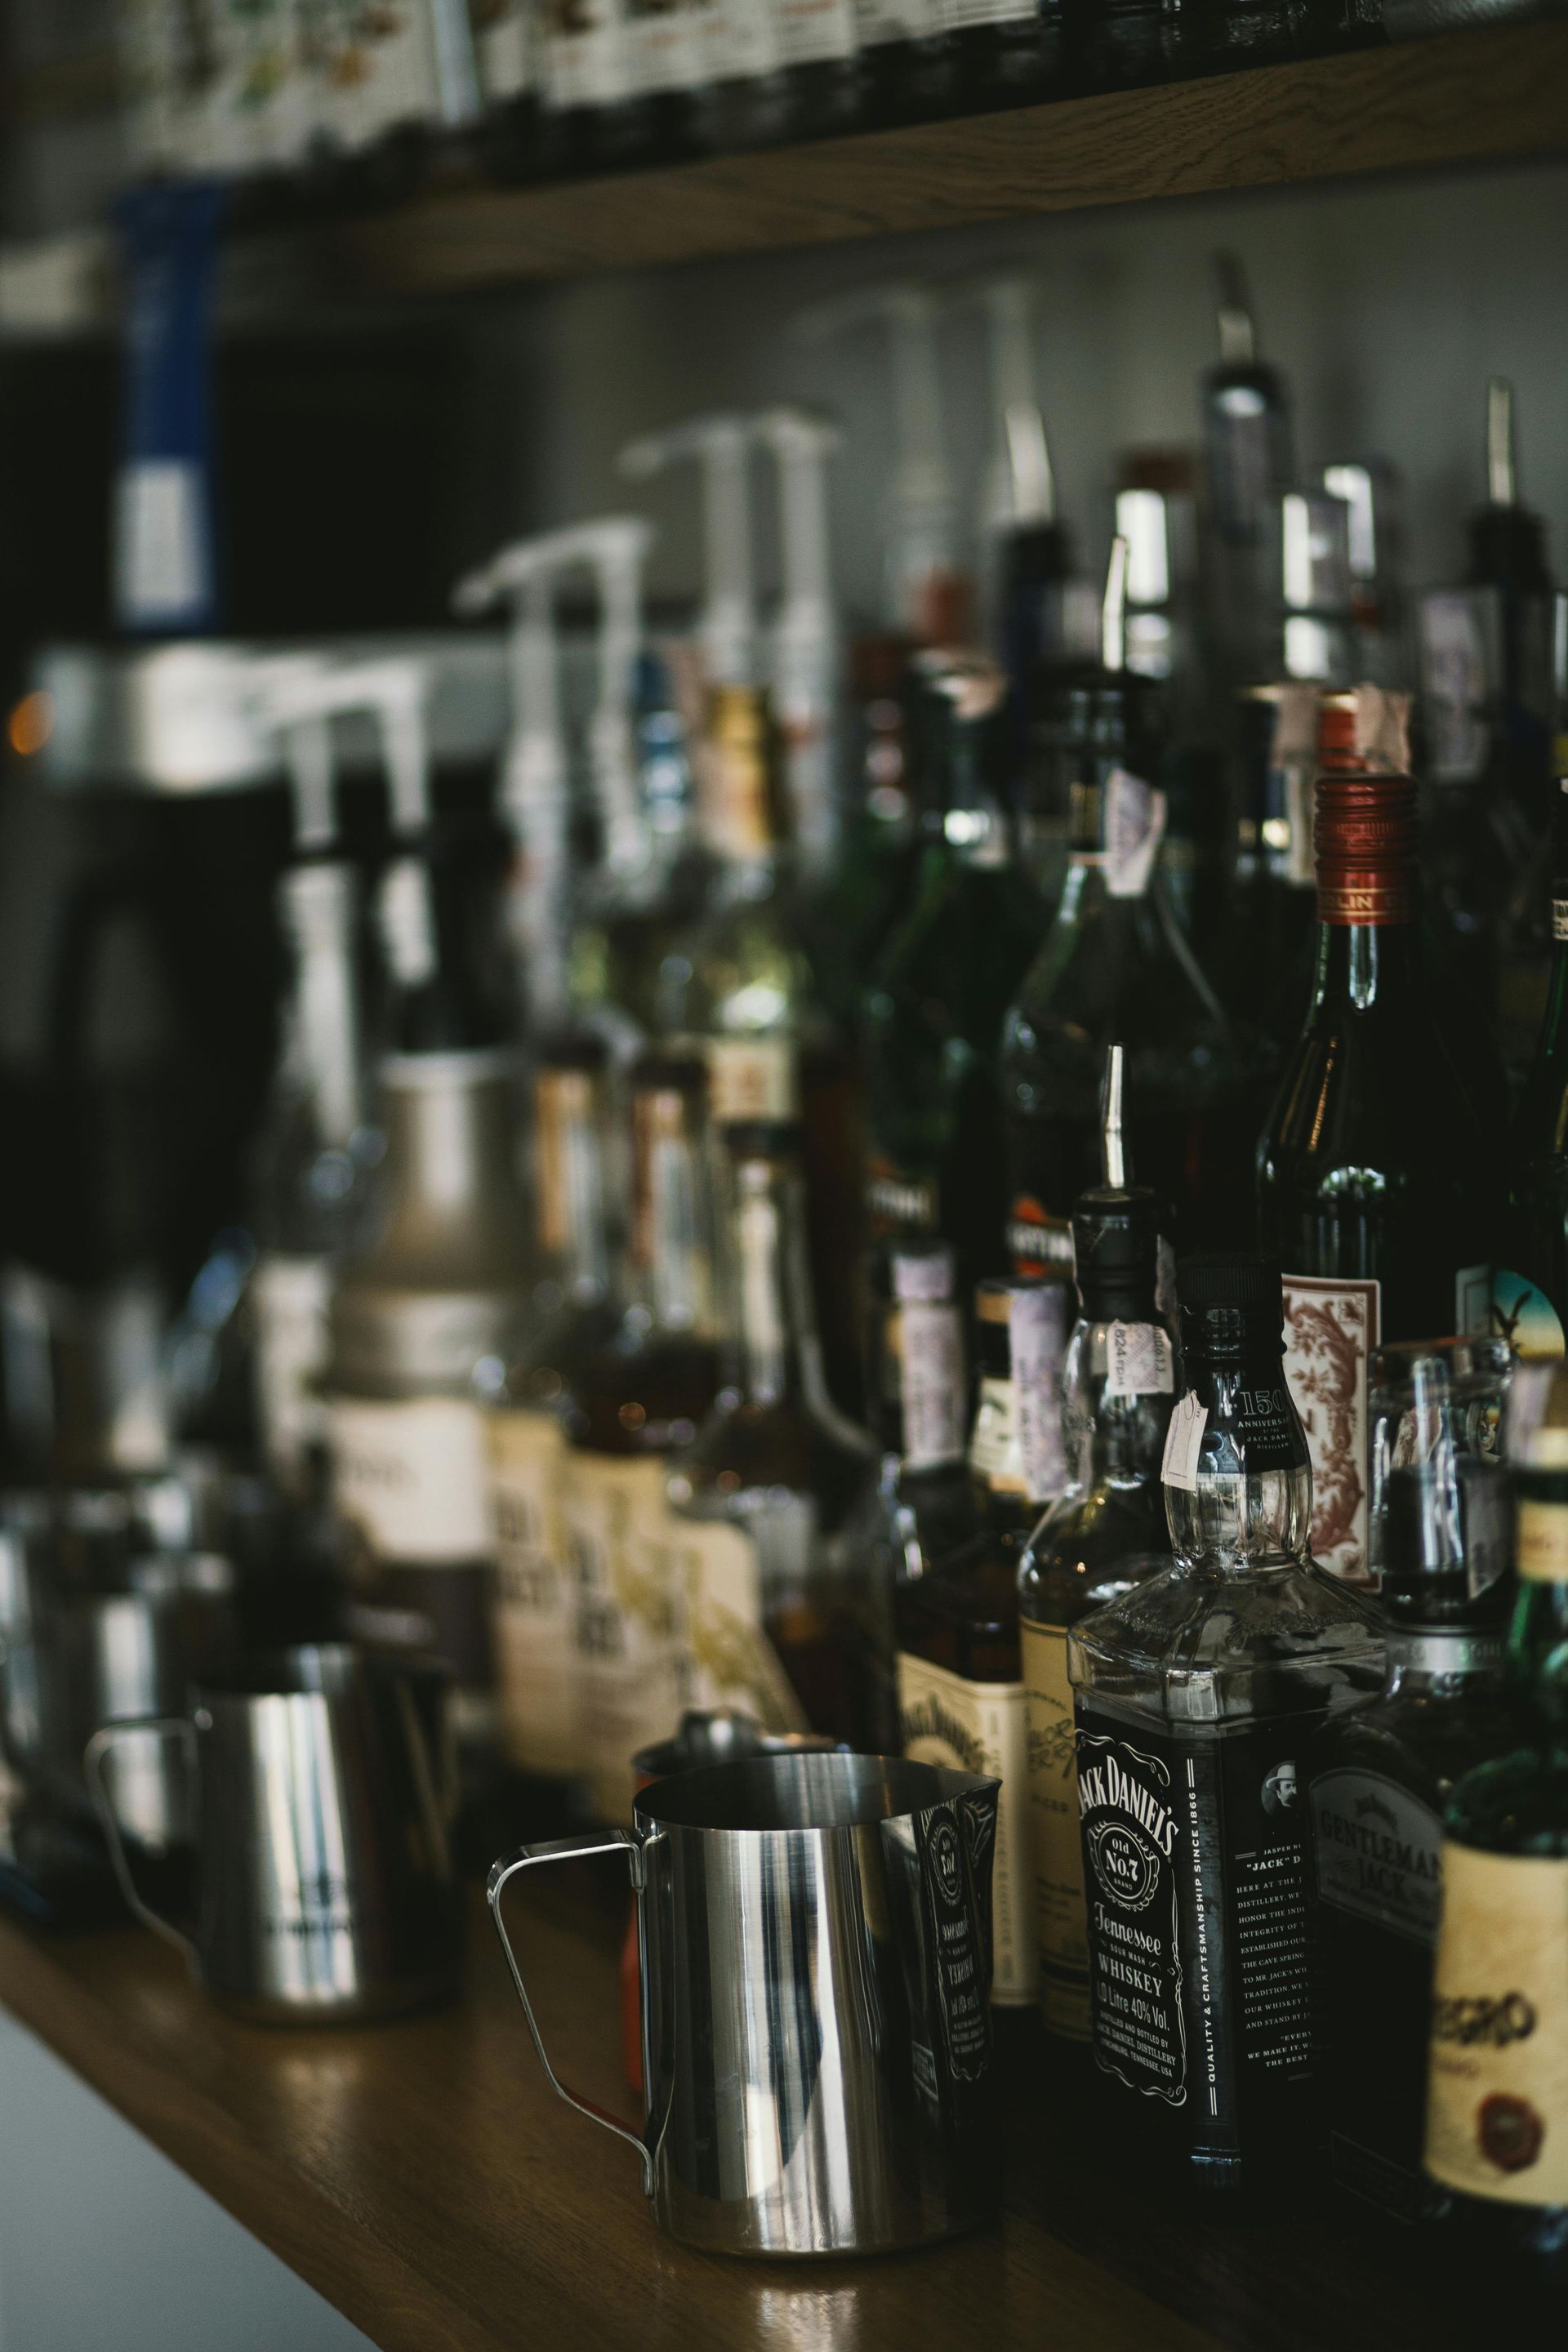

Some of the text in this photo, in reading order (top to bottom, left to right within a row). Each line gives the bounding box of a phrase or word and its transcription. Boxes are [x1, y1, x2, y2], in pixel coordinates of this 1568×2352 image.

[1240, 1389, 1286, 1415] 150
[1237, 1418, 1288, 1428] ANNIVERS
[1077, 1754, 1179, 1855] JACK DANIEL'S
[1111, 1838, 1129, 1855] Old
[1263, 1845, 1291, 1855] JASPER
[1105, 1848, 1138, 1882] No.7
[1246, 1857, 1290, 1871] "JACK"
[1113, 1878, 1133, 1891] BRAND
[1236, 1883, 1259, 1894] HERE
[1263, 1881, 1274, 1889] AT
[1277, 1878, 1295, 1886] THE
[1239, 1913, 1267, 1924] HONOR
[1269, 1909, 1285, 1918] THE
[1094, 1900, 1161, 1956] Tennessee
[1239, 1925, 1285, 1939] INTEGRITY
[1287, 1922, 1297, 1931] OF
[1188, 1792, 1216, 2082] QUALITY & CRAFTSMANSHIP SINCE 1866
[1110, 1943, 1146, 1966] SOUR MASH
[1241, 1940, 1289, 1954] ESTABLISHED
[1241, 1960, 1257, 1969] THE
[1258, 1957, 1278, 1967] CAVE
[1098, 1952, 1162, 1998] WHISKEY
[1268, 1969, 1293, 1980] JACK'S
[1291, 1982, 1303, 1990] WE
[1108, 1985, 1129, 2013] Litre
[1131, 1996, 1152, 2024] 40%
[1152, 2005, 1169, 2032] Vol.
[1245, 2006, 1263, 2014] OUR
[1265, 1998, 1302, 2011] WHISKEY
[1245, 2020, 1263, 2029] AND
[1264, 2016, 1290, 2026] STAND
[1292, 2012, 1301, 2020] BY
[1137, 2027, 1160, 2045] BOTTLED
[1160, 2038, 1169, 2049] BY
[1136, 2040, 1176, 2066] DISTILLERY
[1247, 2051, 1260, 2060] WE
[1263, 2046, 1288, 2056] MAKE
[1265, 2054, 1307, 2068] THE BEST
[1160, 2062, 1173, 2078] USA
